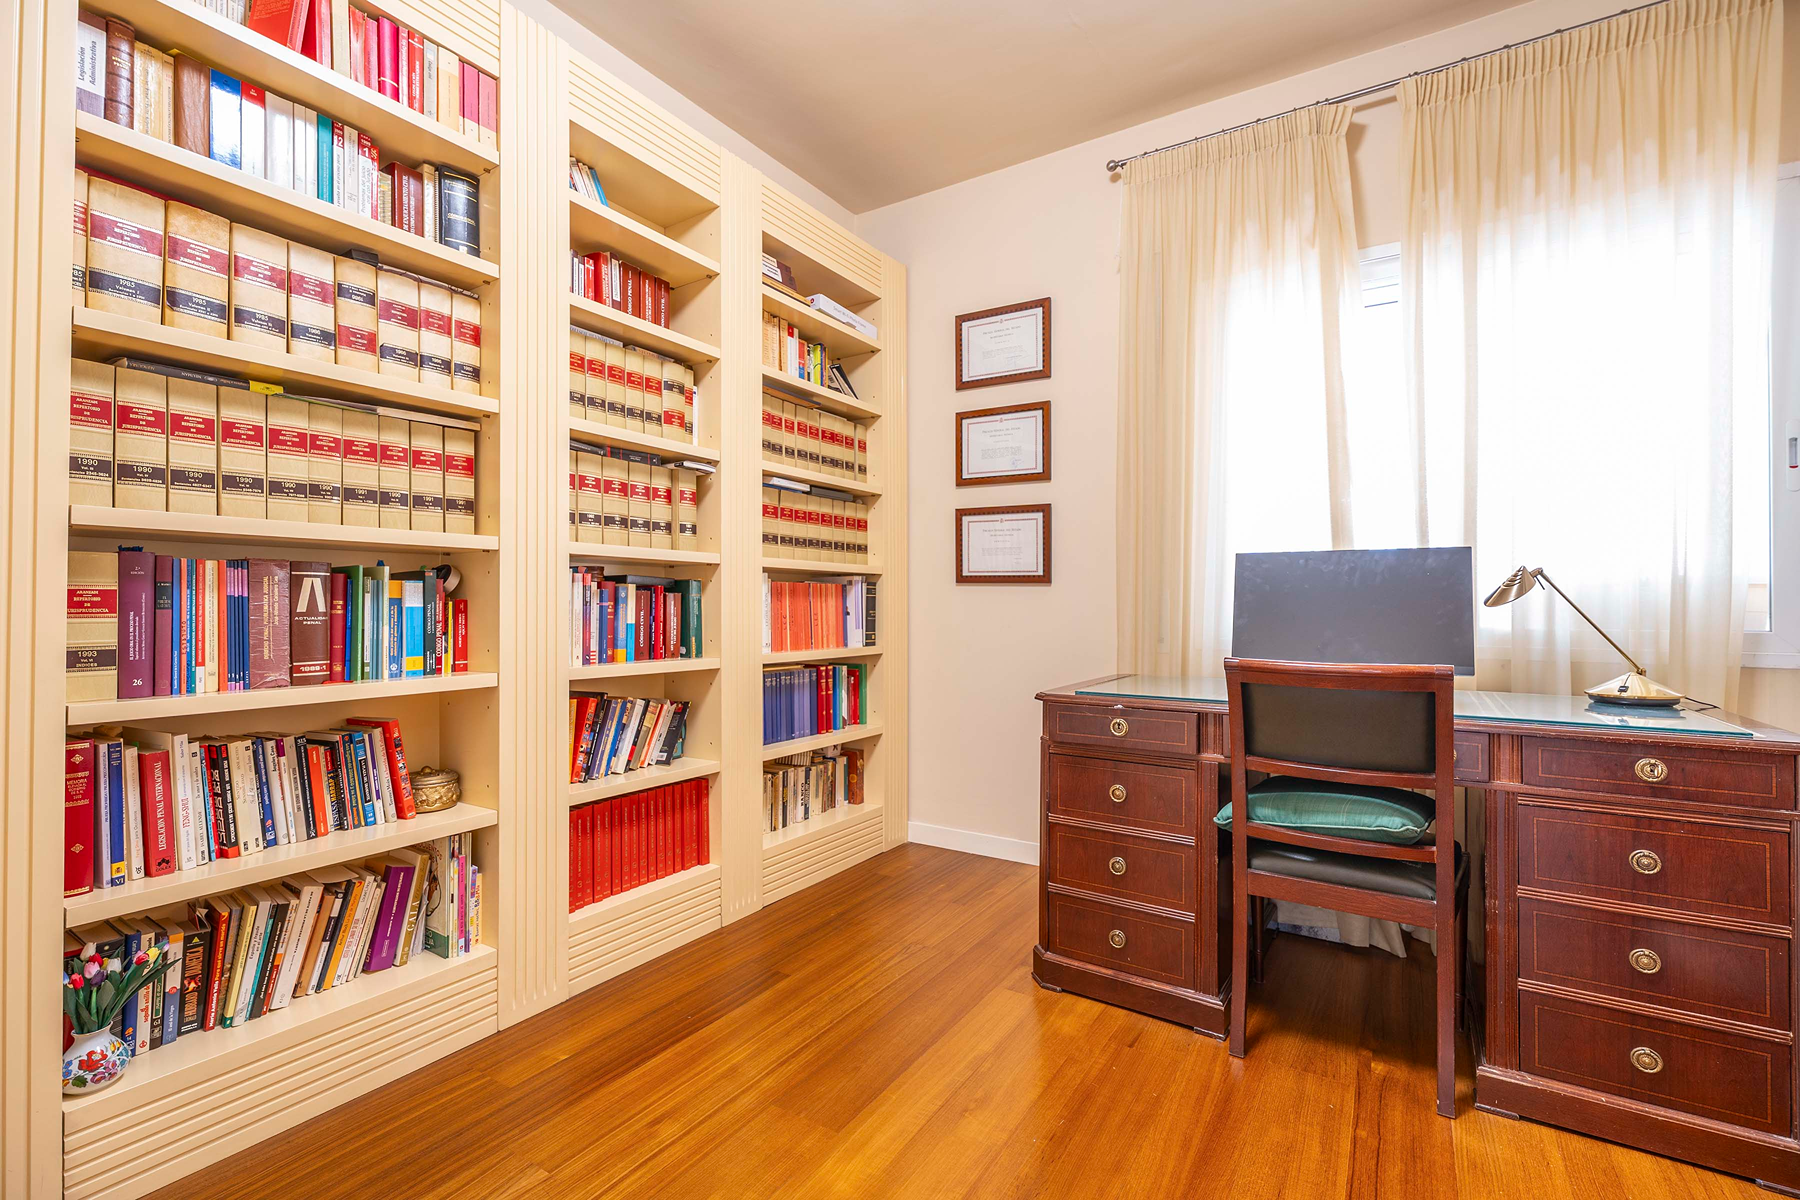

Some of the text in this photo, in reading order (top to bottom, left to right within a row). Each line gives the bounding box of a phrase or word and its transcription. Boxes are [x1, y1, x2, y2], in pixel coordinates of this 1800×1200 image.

[78, 46, 86, 81] Legislación
[119, 279, 135, 287] 1985
[122, 424, 162, 433] JURISPRUDENCIA
[77, 458, 98, 466] 1990
[133, 465, 152, 473] 1990
[236, 476, 253, 484] 1990
[132, 678, 143, 686] 26
[328, 773, 337, 801] HARRAP'S
[154, 761, 167, 851] LEGISLACION PENAL INTERNACIONAL
[181, 797, 190, 829] FENG-SHUI
[406, 900, 420, 931] GALA
[249, 944, 257, 959] Expolio
[293, 938, 302, 953] MUERTA
[183, 992, 198, 1016] HUBBARD
[210, 993, 218, 1012] Antonia
